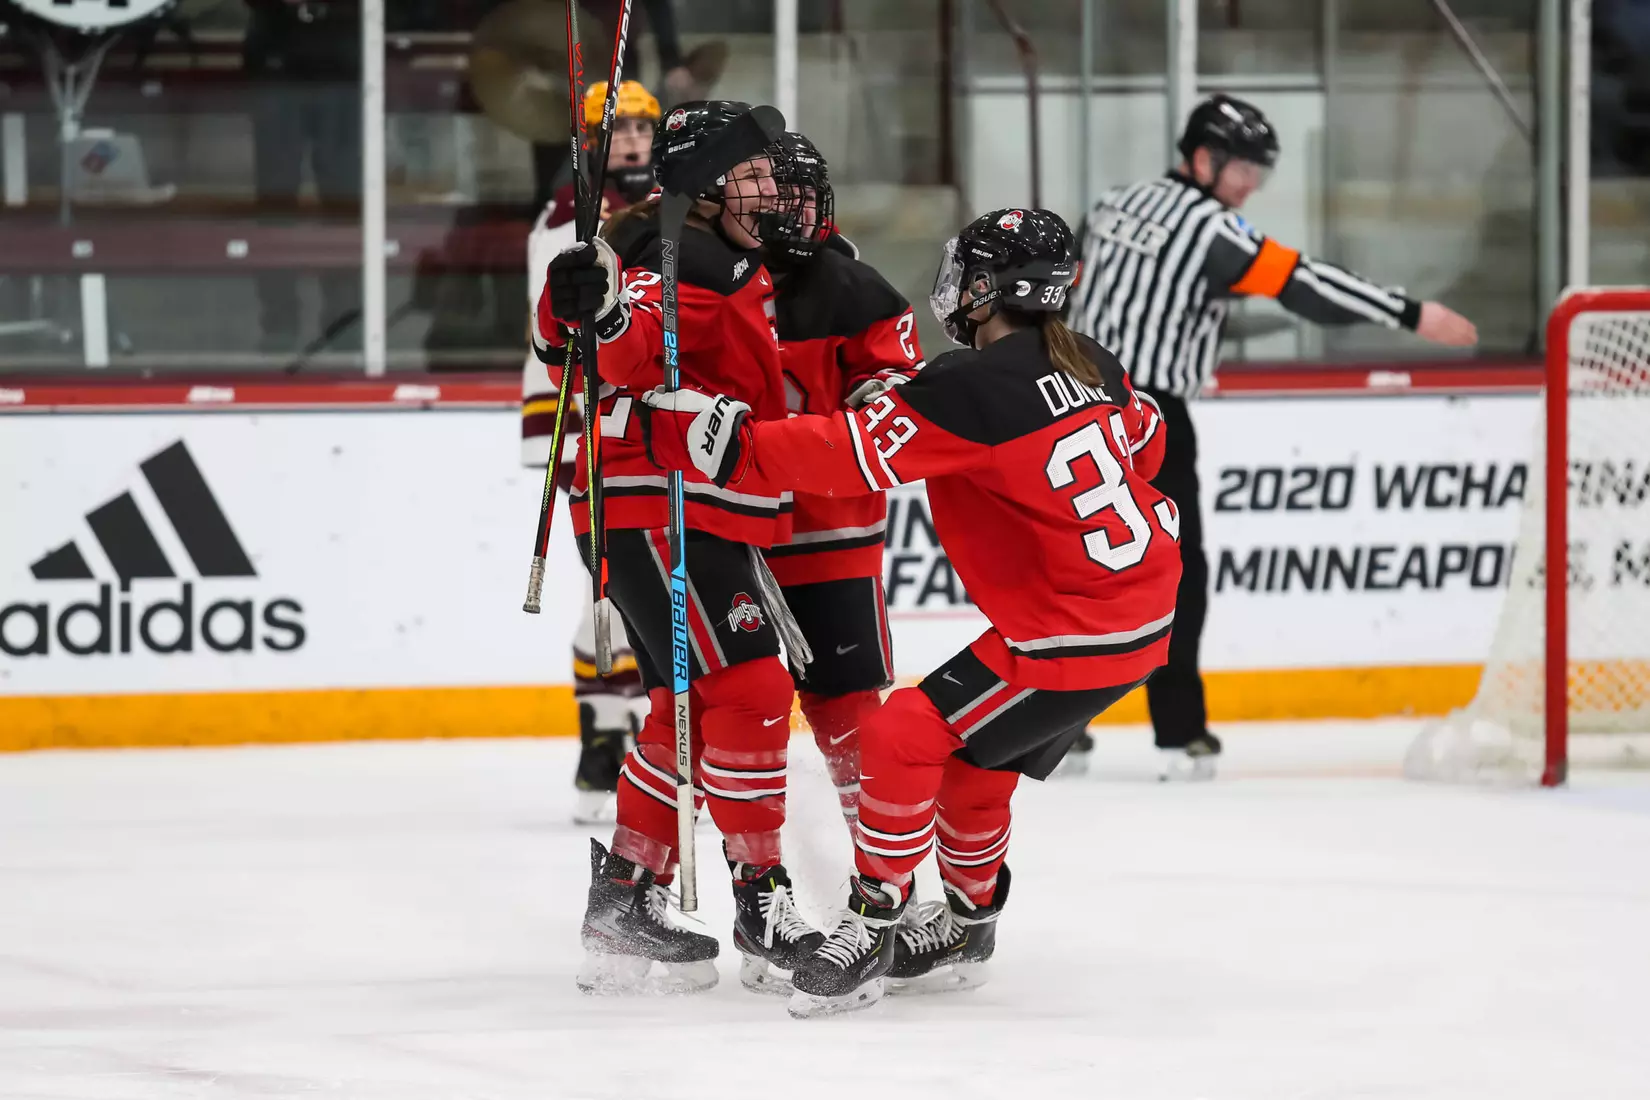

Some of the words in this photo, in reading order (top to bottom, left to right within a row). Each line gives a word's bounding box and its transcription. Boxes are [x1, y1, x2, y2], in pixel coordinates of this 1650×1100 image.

[601, 97, 611, 130] BAUER
[971, 248, 994, 259] BAUER
[662, 238, 676, 332] NEXUS
[972, 290, 1001, 309] BAUE
[1041, 285, 1064, 304] 33
[701, 395, 736, 456] UER
[1214, 466, 1354, 512] 2020
[1374, 463, 1528, 510] WCHA
[0, 583, 306, 657] adidas
[672, 588, 687, 682] BAUER
[678, 704, 687, 767] NEXUS
